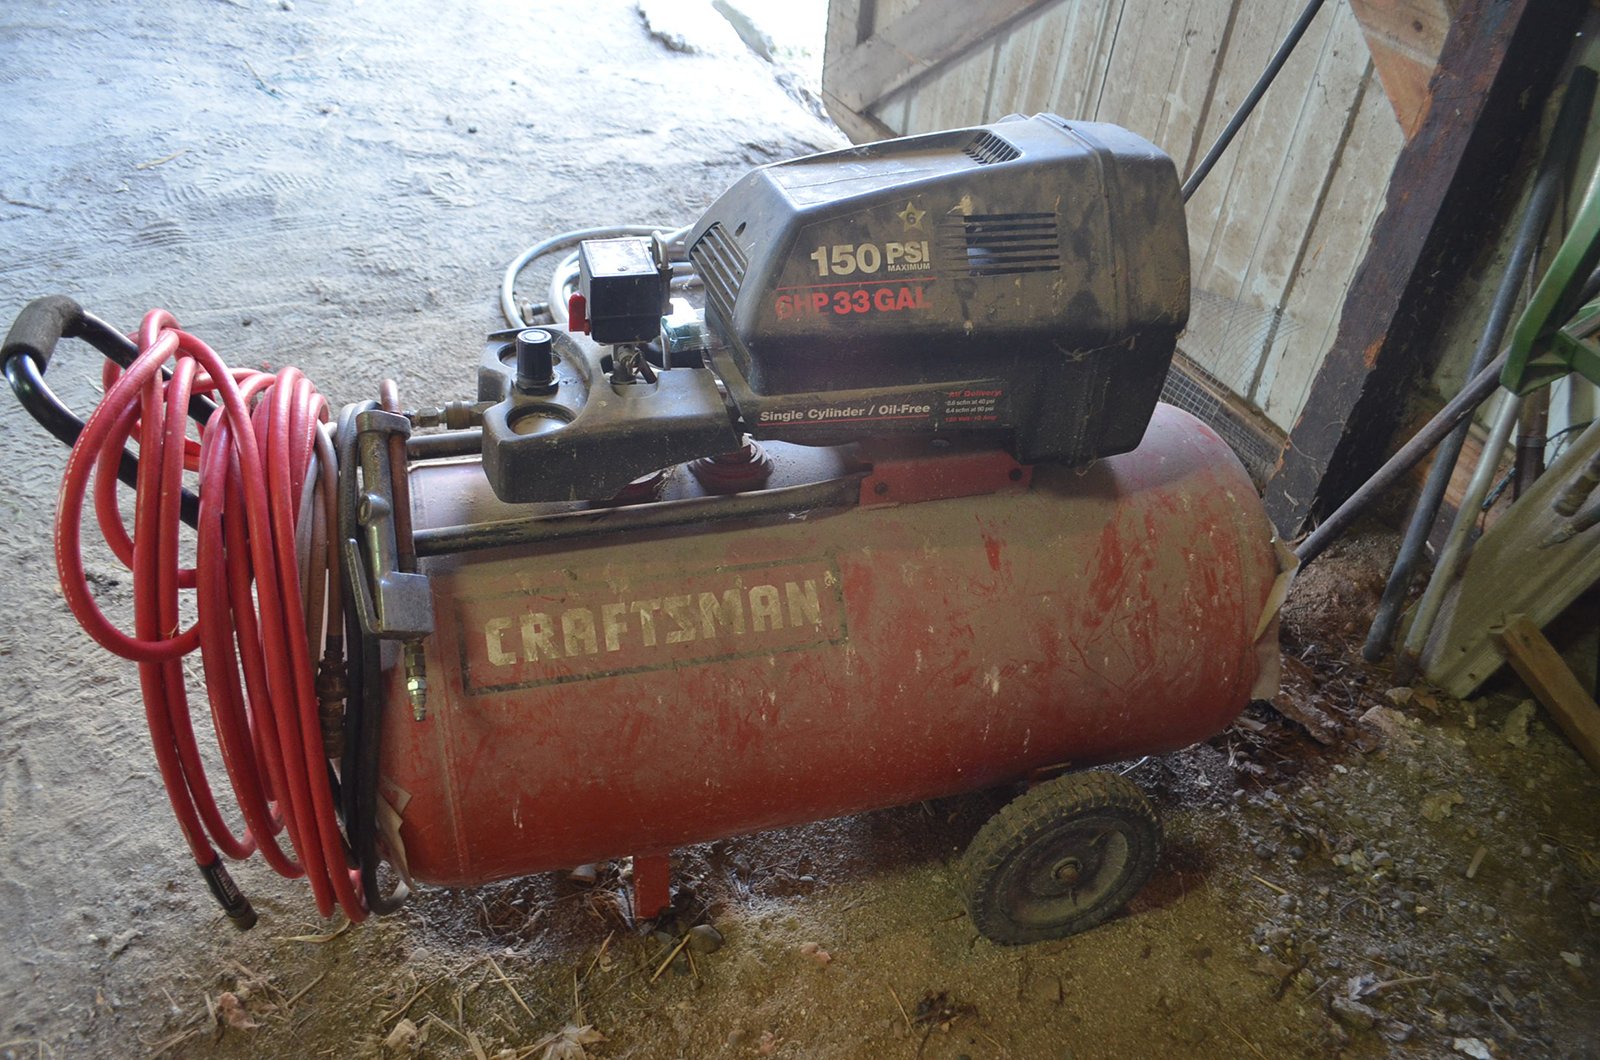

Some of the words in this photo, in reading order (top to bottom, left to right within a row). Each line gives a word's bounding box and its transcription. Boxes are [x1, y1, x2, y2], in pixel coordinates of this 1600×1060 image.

[906, 212, 916, 223] 6
[811, 243, 881, 277] 150
[885, 241, 930, 264] PSI
[887, 263, 931, 272] MAXIMUM
[775, 292, 829, 320] 6HP
[833, 290, 871, 315] 33
[874, 287, 932, 312] GAL
[759, 410, 804, 423] Single
[808, 406, 865, 420] Cylinder
[868, 405, 876, 416] /
[878, 404, 931, 416] Oil-Free
[485, 579, 822, 667] CRAFTSMAN
